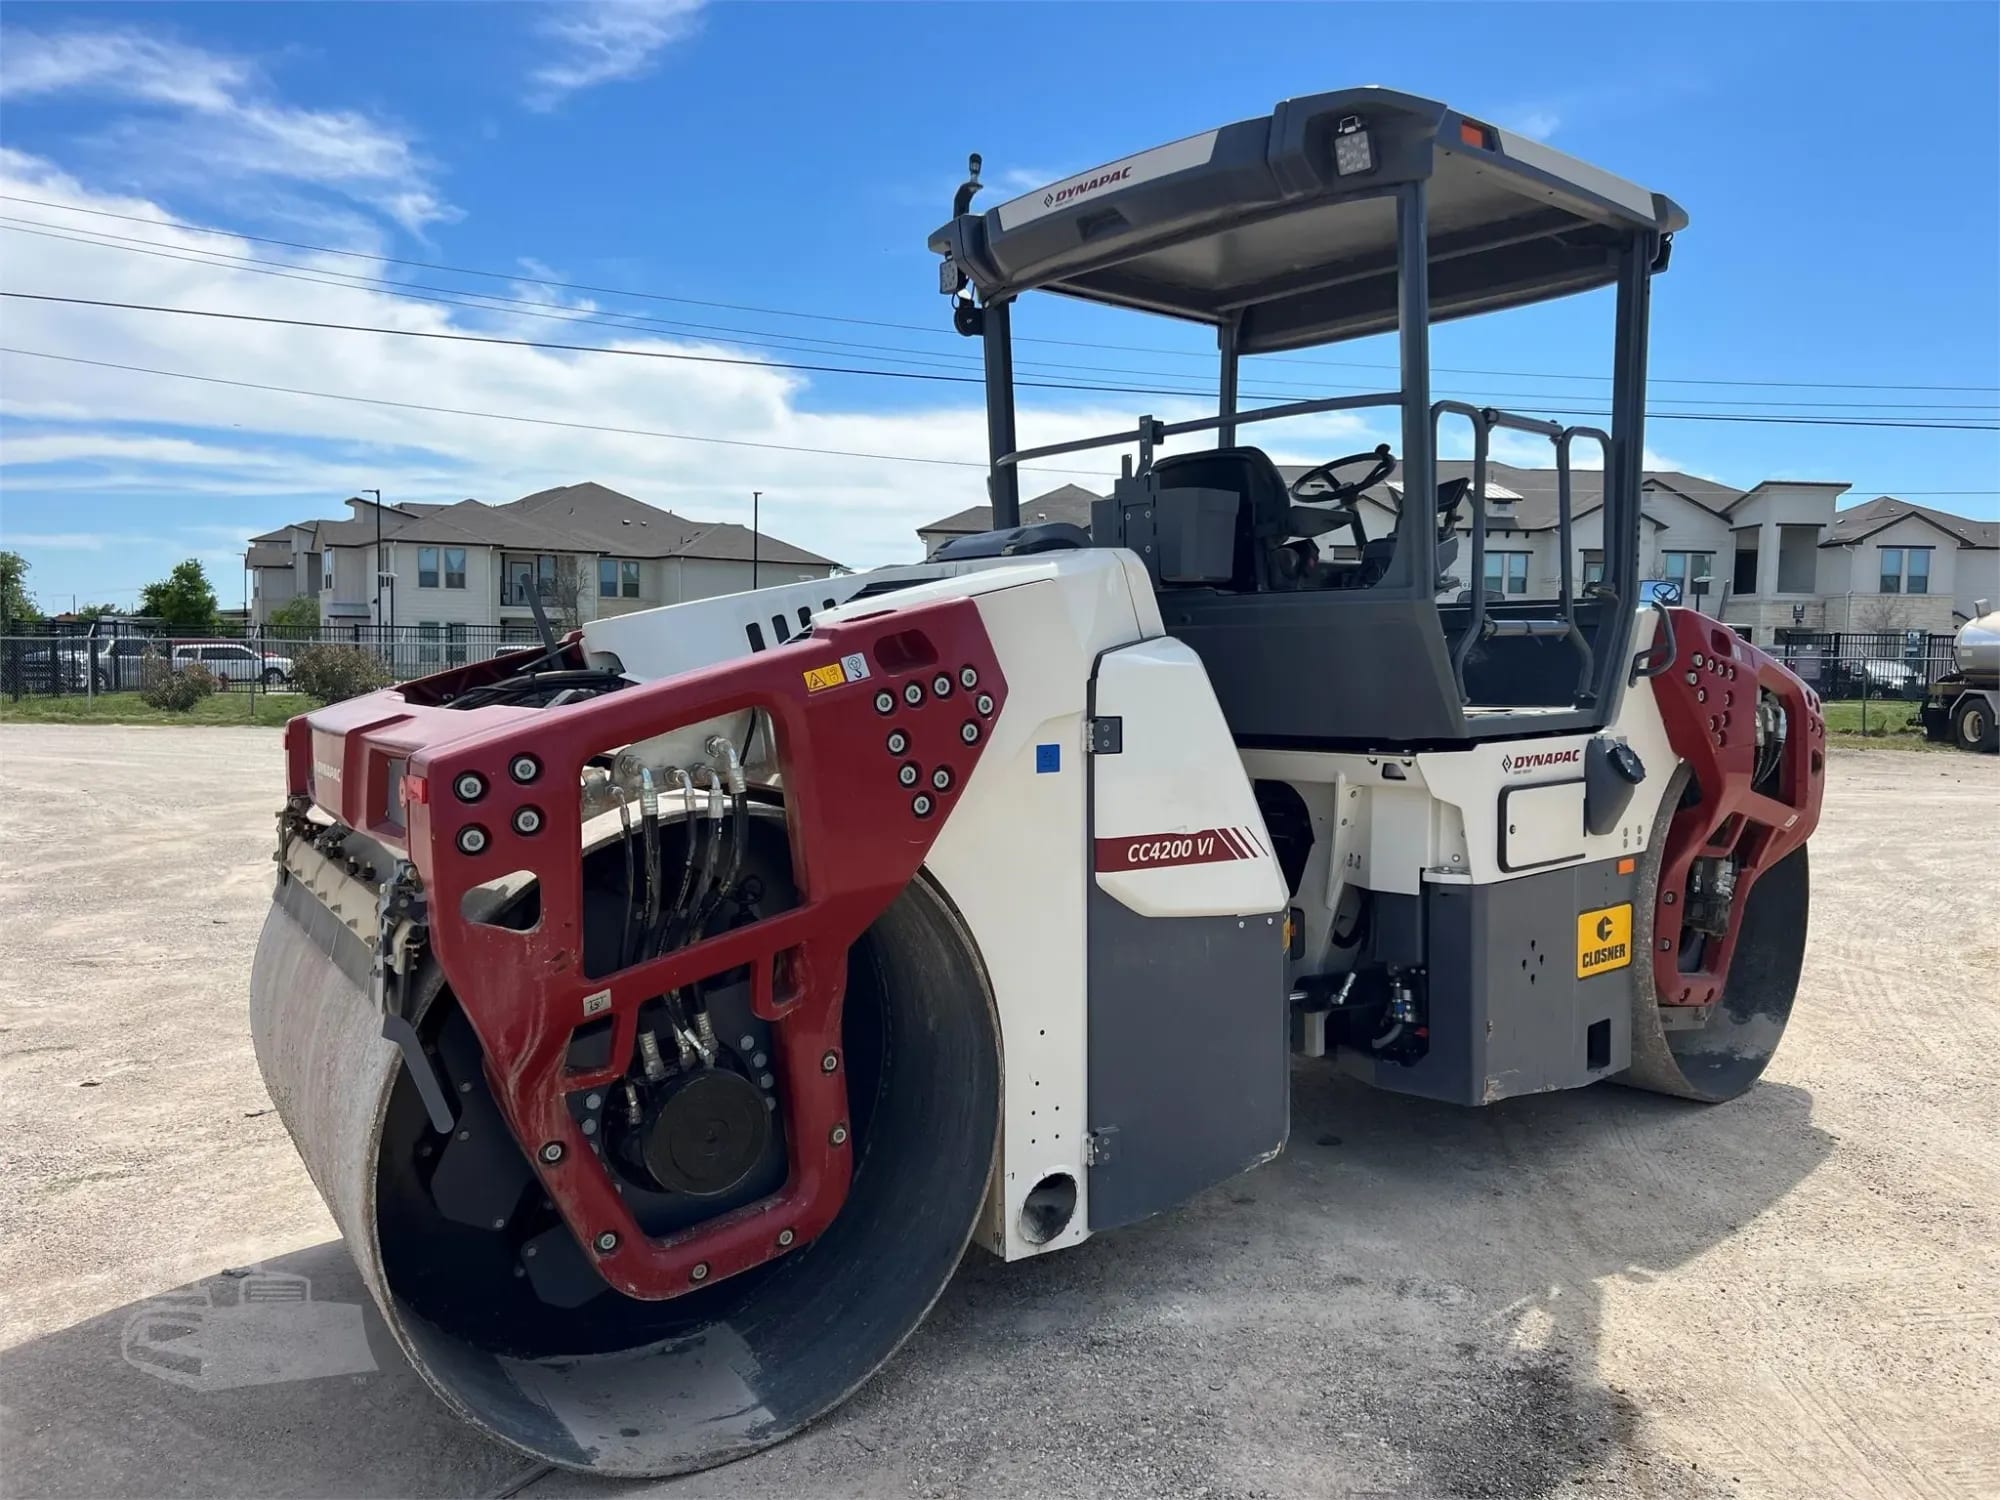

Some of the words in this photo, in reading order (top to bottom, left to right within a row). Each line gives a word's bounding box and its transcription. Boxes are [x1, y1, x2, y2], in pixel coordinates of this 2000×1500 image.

[1055, 166, 1132, 202] DYNAPAC
[1514, 749, 1580, 769] DYNAPAC
[1127, 839, 1192, 863] CC4200
[1197, 837, 1215, 856] VI
[1582, 943, 1626, 968] CLOSNER
